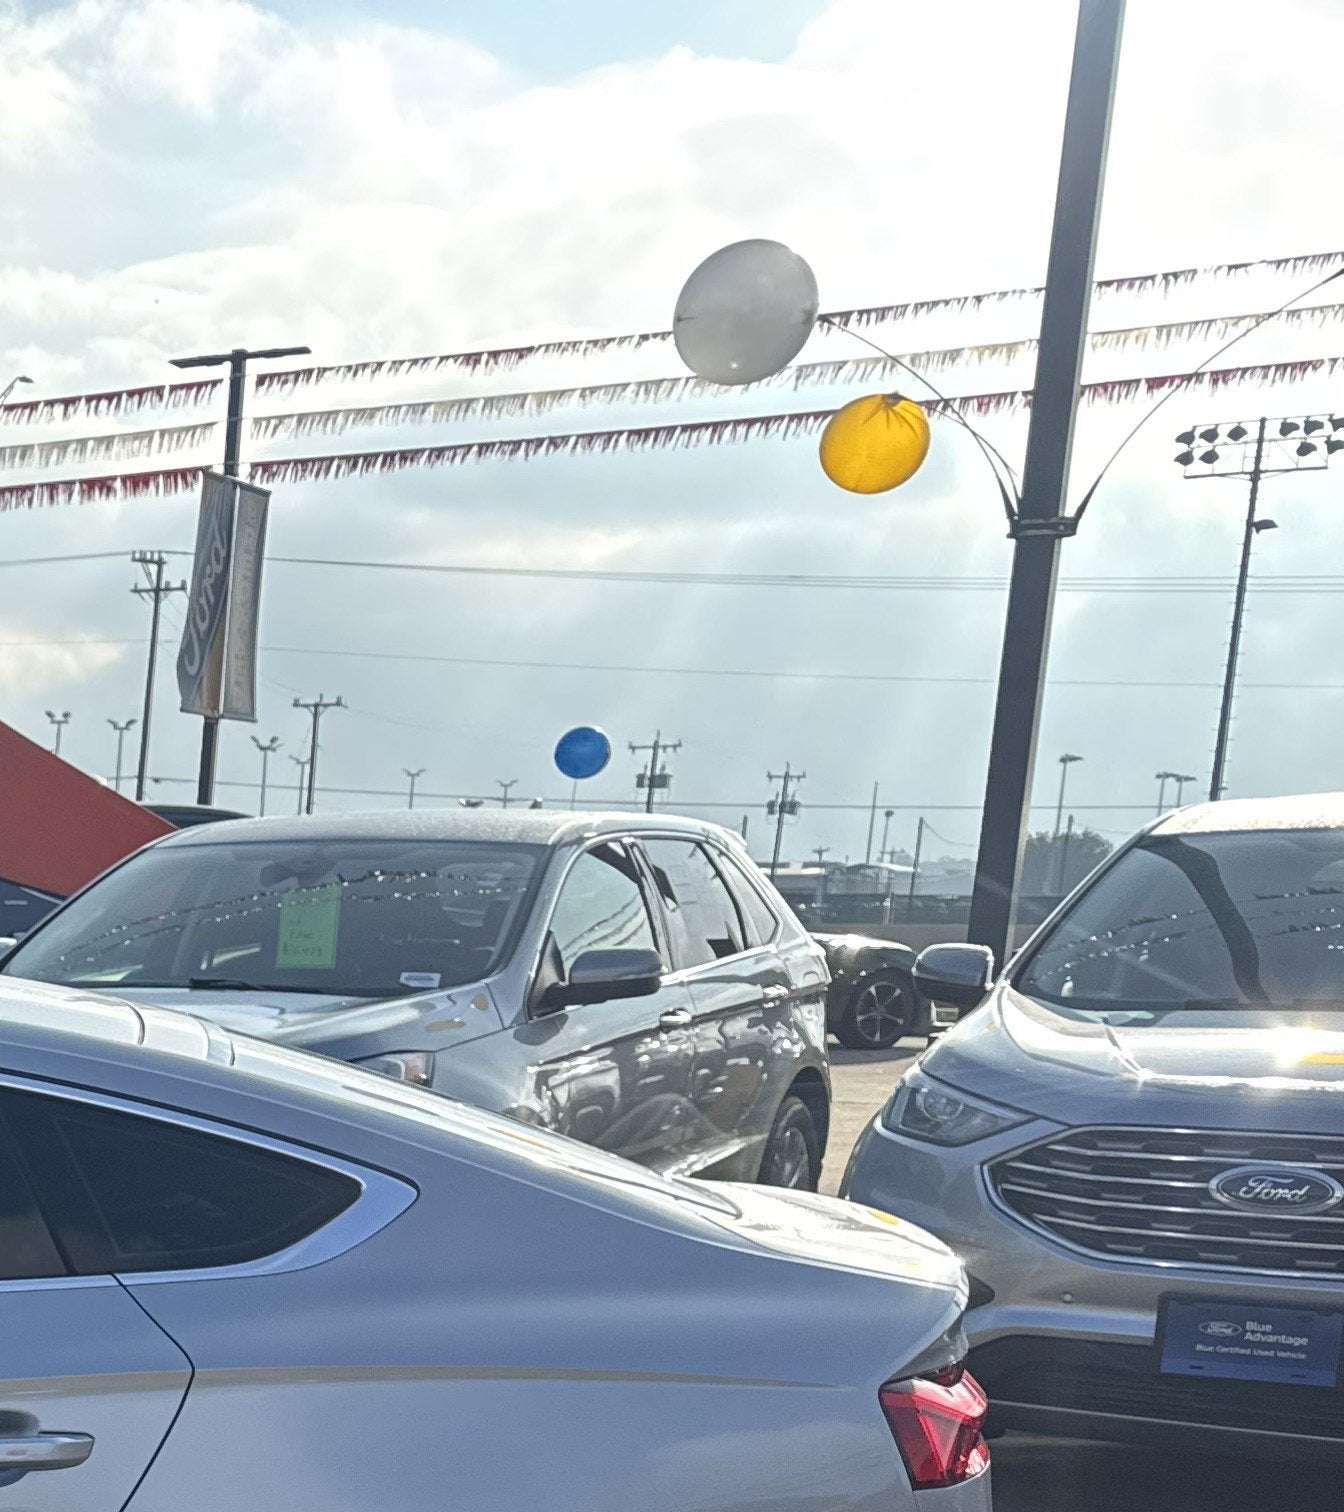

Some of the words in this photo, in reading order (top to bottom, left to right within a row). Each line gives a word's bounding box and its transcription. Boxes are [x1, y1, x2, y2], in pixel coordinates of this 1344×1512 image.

[1239, 1175, 1310, 1201] Ford
[1245, 1320, 1273, 1333] Blue
[1243, 1331, 1309, 1347] Advantage
